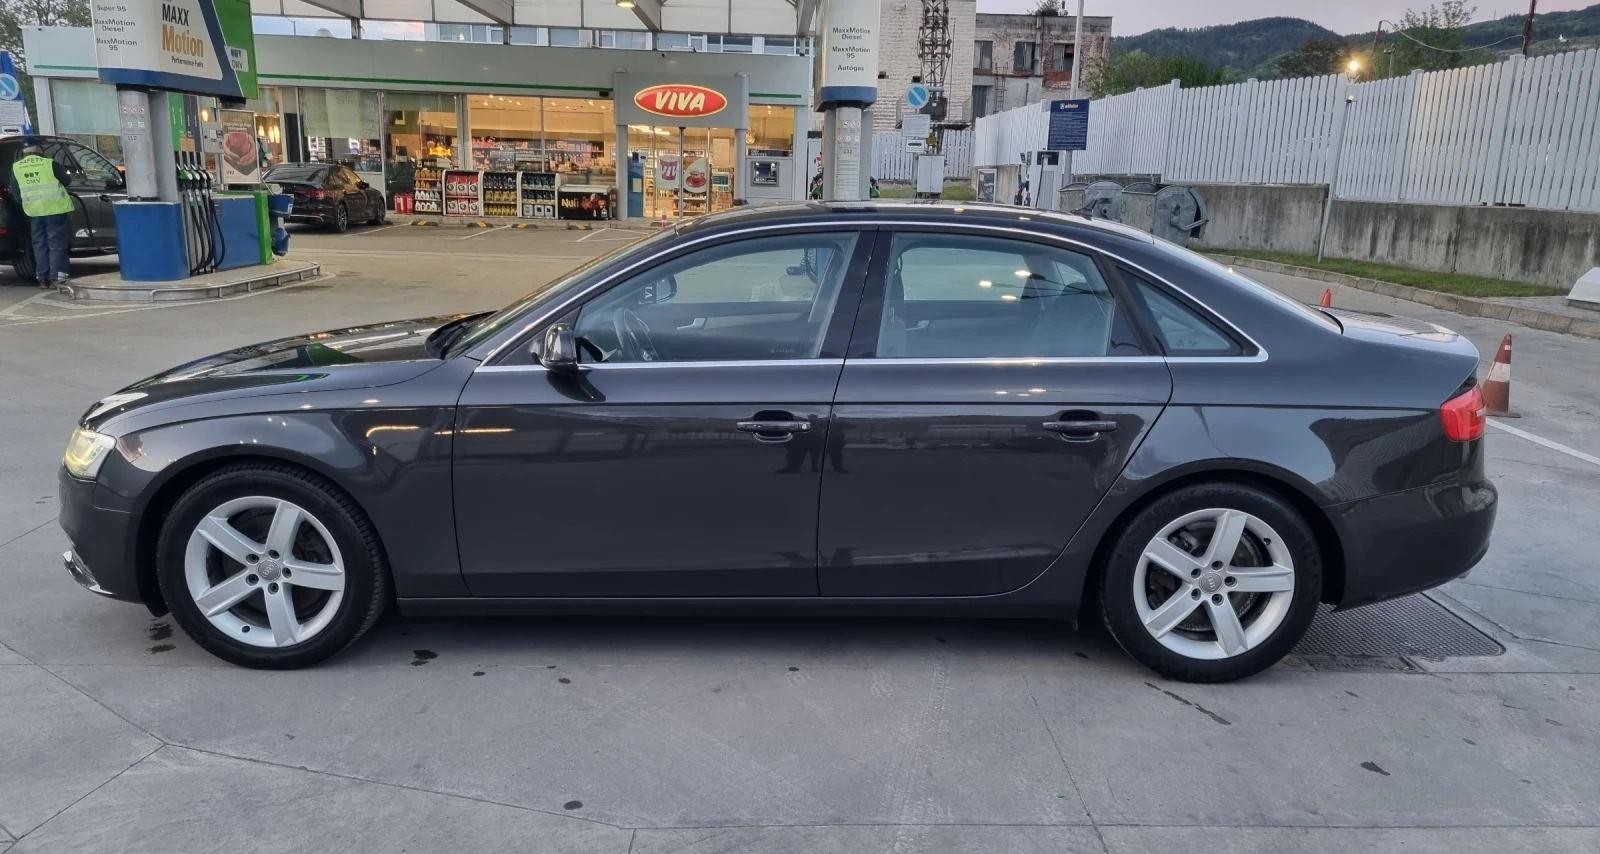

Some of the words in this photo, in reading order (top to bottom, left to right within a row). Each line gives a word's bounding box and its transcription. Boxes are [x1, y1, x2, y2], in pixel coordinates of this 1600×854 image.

[162, 3, 189, 26] MAXX
[102, 25, 124, 33] Diesel
[162, 23, 204, 58] Motion
[832, 45, 871, 53] MaxxMotion
[171, 55, 195, 66] Performance
[837, 64, 865, 72] Autogas
[655, 90, 706, 112] VIVA
